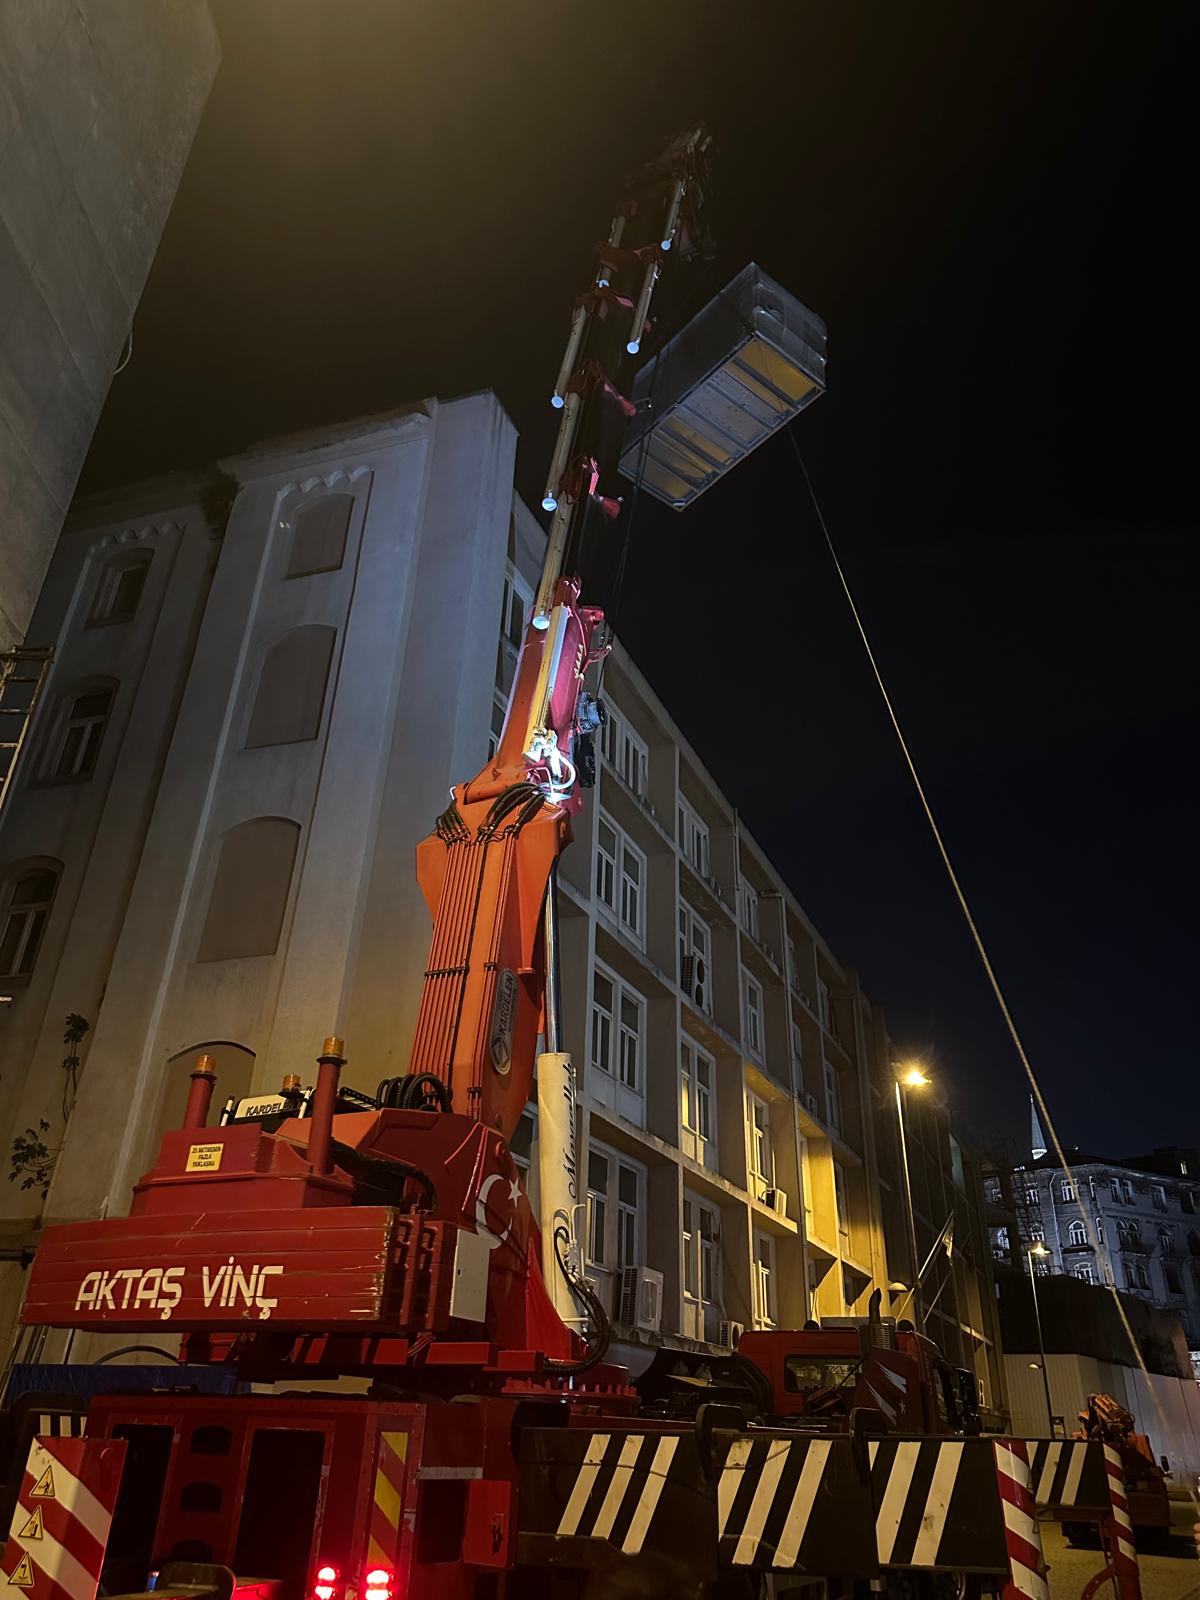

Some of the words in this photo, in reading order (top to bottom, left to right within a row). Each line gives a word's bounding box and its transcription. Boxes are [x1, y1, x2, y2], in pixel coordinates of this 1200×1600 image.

[498, 975, 513, 1036] KARDELEN
[74, 1266, 187, 1320] AKTAŞ
[202, 1256, 284, 1320] VİNÇ
